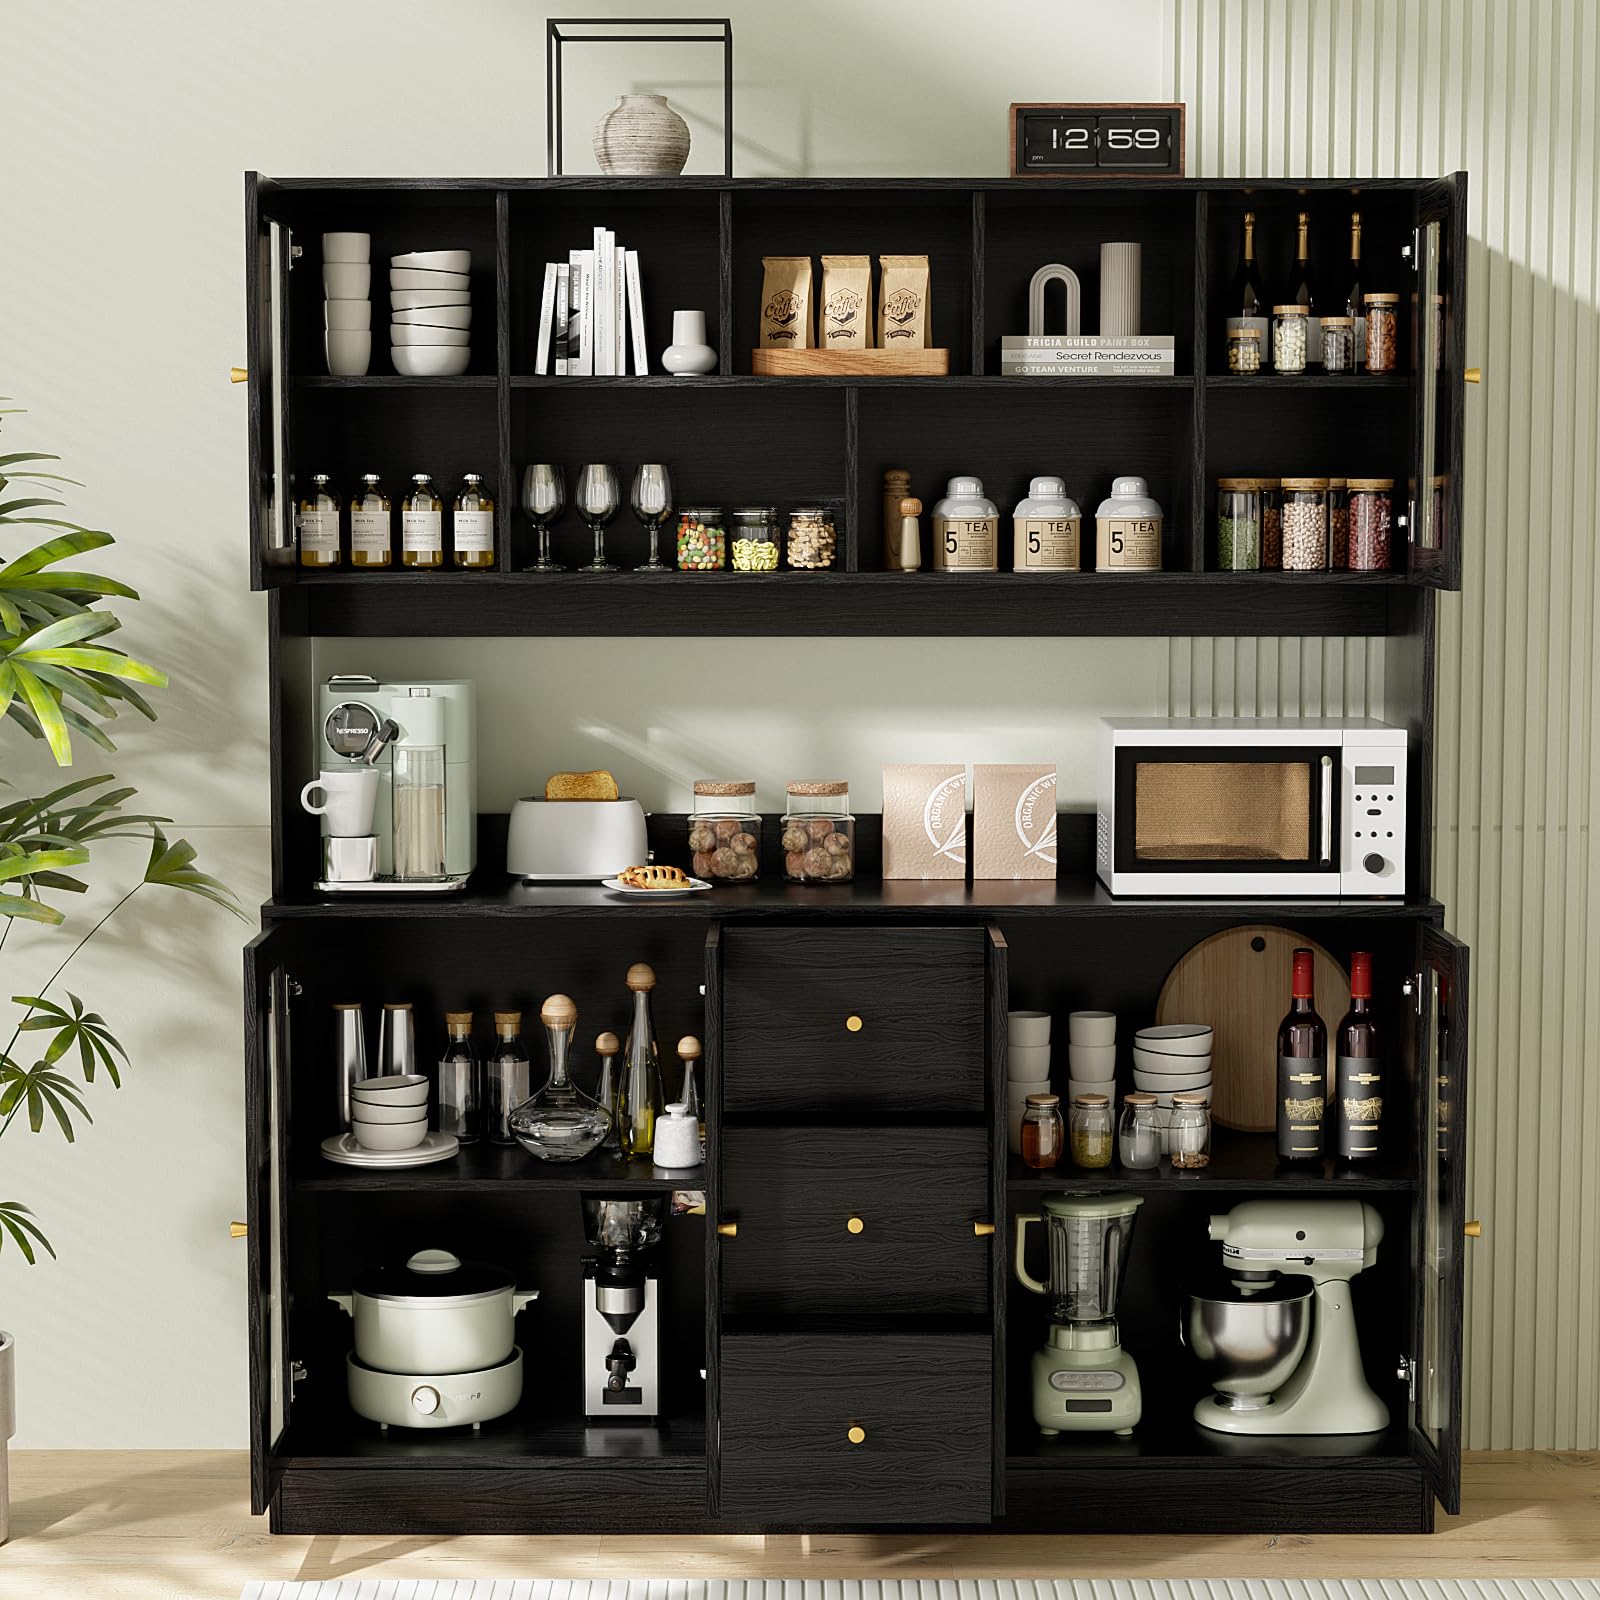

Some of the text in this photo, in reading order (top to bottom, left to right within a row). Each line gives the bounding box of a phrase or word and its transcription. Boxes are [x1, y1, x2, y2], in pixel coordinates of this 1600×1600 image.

[764, 297, 804, 320] Coffee
[824, 296, 863, 319] Coffee
[882, 296, 921, 320] Coffee
[1026, 339, 1150, 347] TRICIA GUILD PAINT BOX
[1056, 351, 1162, 360] Secret Rendezvous
[965, 522, 989, 532] TEA
[1049, 522, 1072, 532] TEA
[1131, 522, 1155, 532] TEA
[945, 531, 958, 554] 5
[1028, 531, 1041, 554] 5
[1111, 531, 1124, 554] 5
[336, 727, 369, 735] NESPRESSO
[930, 787, 953, 829] ORGANIC
[1022, 786, 1044, 829] ORGANIC
